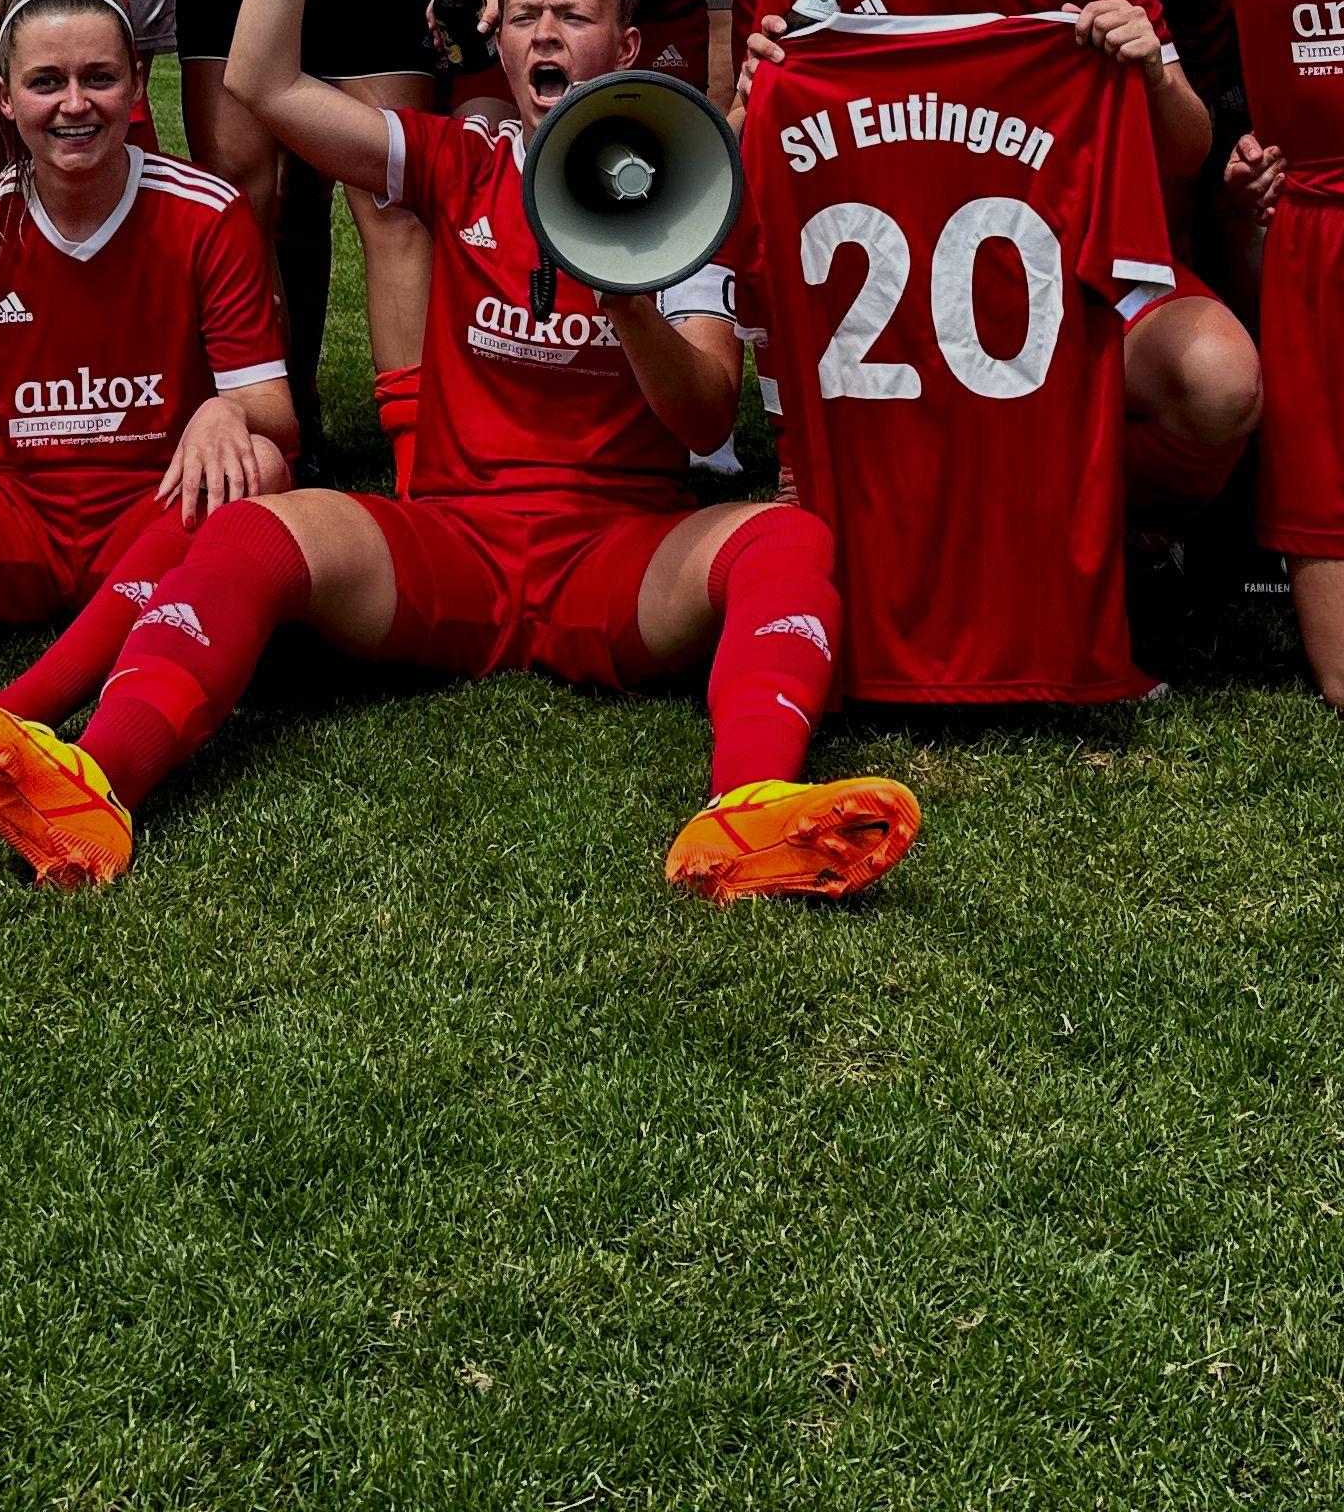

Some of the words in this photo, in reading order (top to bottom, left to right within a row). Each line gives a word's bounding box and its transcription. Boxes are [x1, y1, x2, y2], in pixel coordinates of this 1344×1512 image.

[780, 109, 839, 173] SV
[846, 92, 1054, 171] Eutingen
[476, 296, 620, 347] ankox
[800, 196, 1064, 399] 20
[472, 330, 563, 362] Firmengruppe
[14, 366, 165, 414] ankox
[16, 416, 112, 433] Firmengruppe
[16, 437, 50, 448] X-PERT
